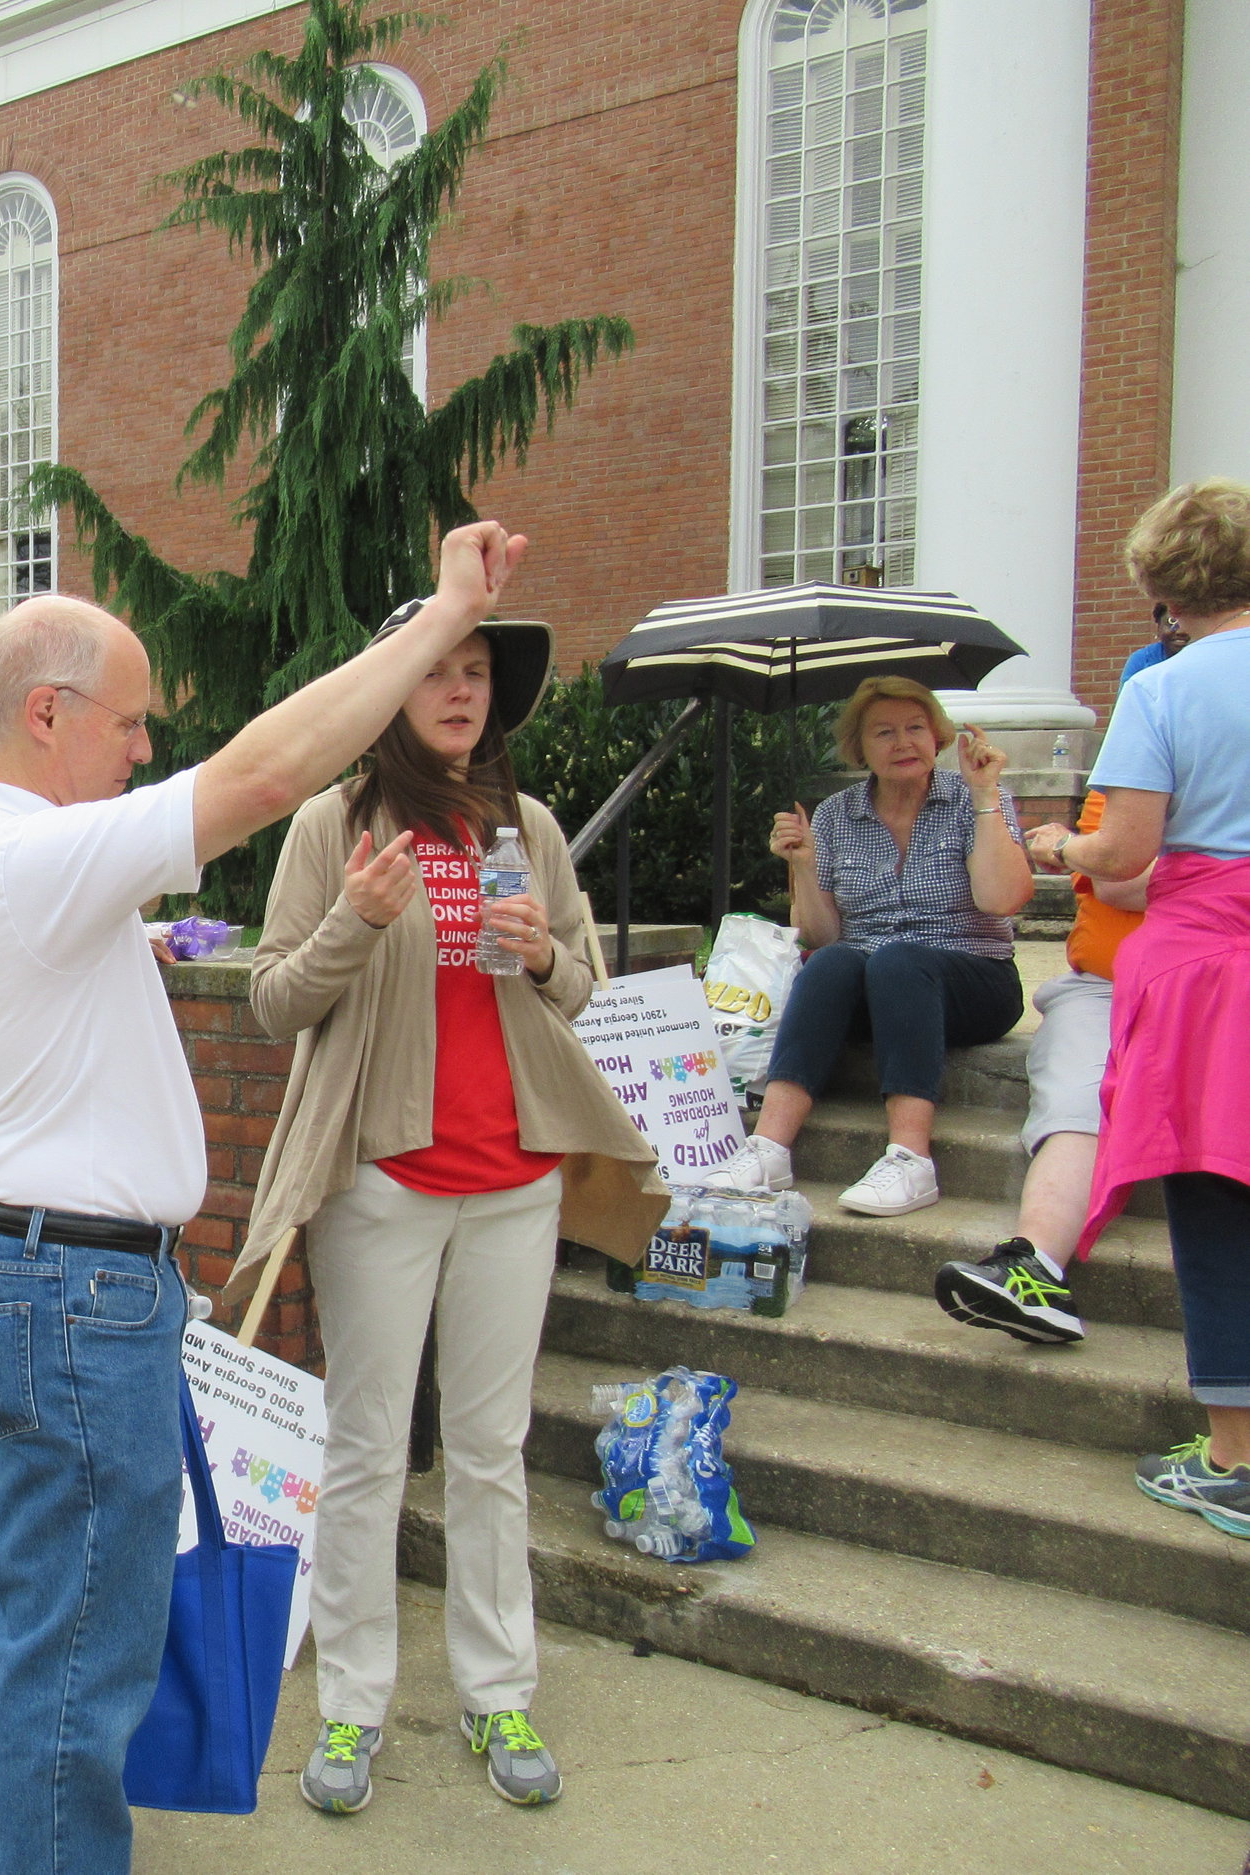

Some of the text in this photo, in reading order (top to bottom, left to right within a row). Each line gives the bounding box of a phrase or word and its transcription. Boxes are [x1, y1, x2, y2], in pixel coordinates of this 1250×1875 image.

[619, 995, 645, 1005] Silver
[603, 1012, 638, 1025] Georgia
[640, 1009, 667, 1021] 12901
[656, 1020, 700, 1032] Glenmont
[625, 1027, 655, 1040] United
[668, 1087, 716, 1107] HOUSING
[663, 1101, 728, 1125] AFFORDABLE
[694, 1119, 709, 1142] for
[674, 1134, 738, 1167] UNITED
[649, 1252, 703, 1277] PARK
[184, 1333, 299, 1392] Silver Spring, MD
[186, 1373, 211, 1394] Met
[214, 1367, 266, 1399] Georgia
[212, 1387, 258, 1417] United
[269, 1393, 305, 1417] 8900
[261, 1407, 307, 1440] Spring
[232, 1499, 304, 1547] HOUSING
